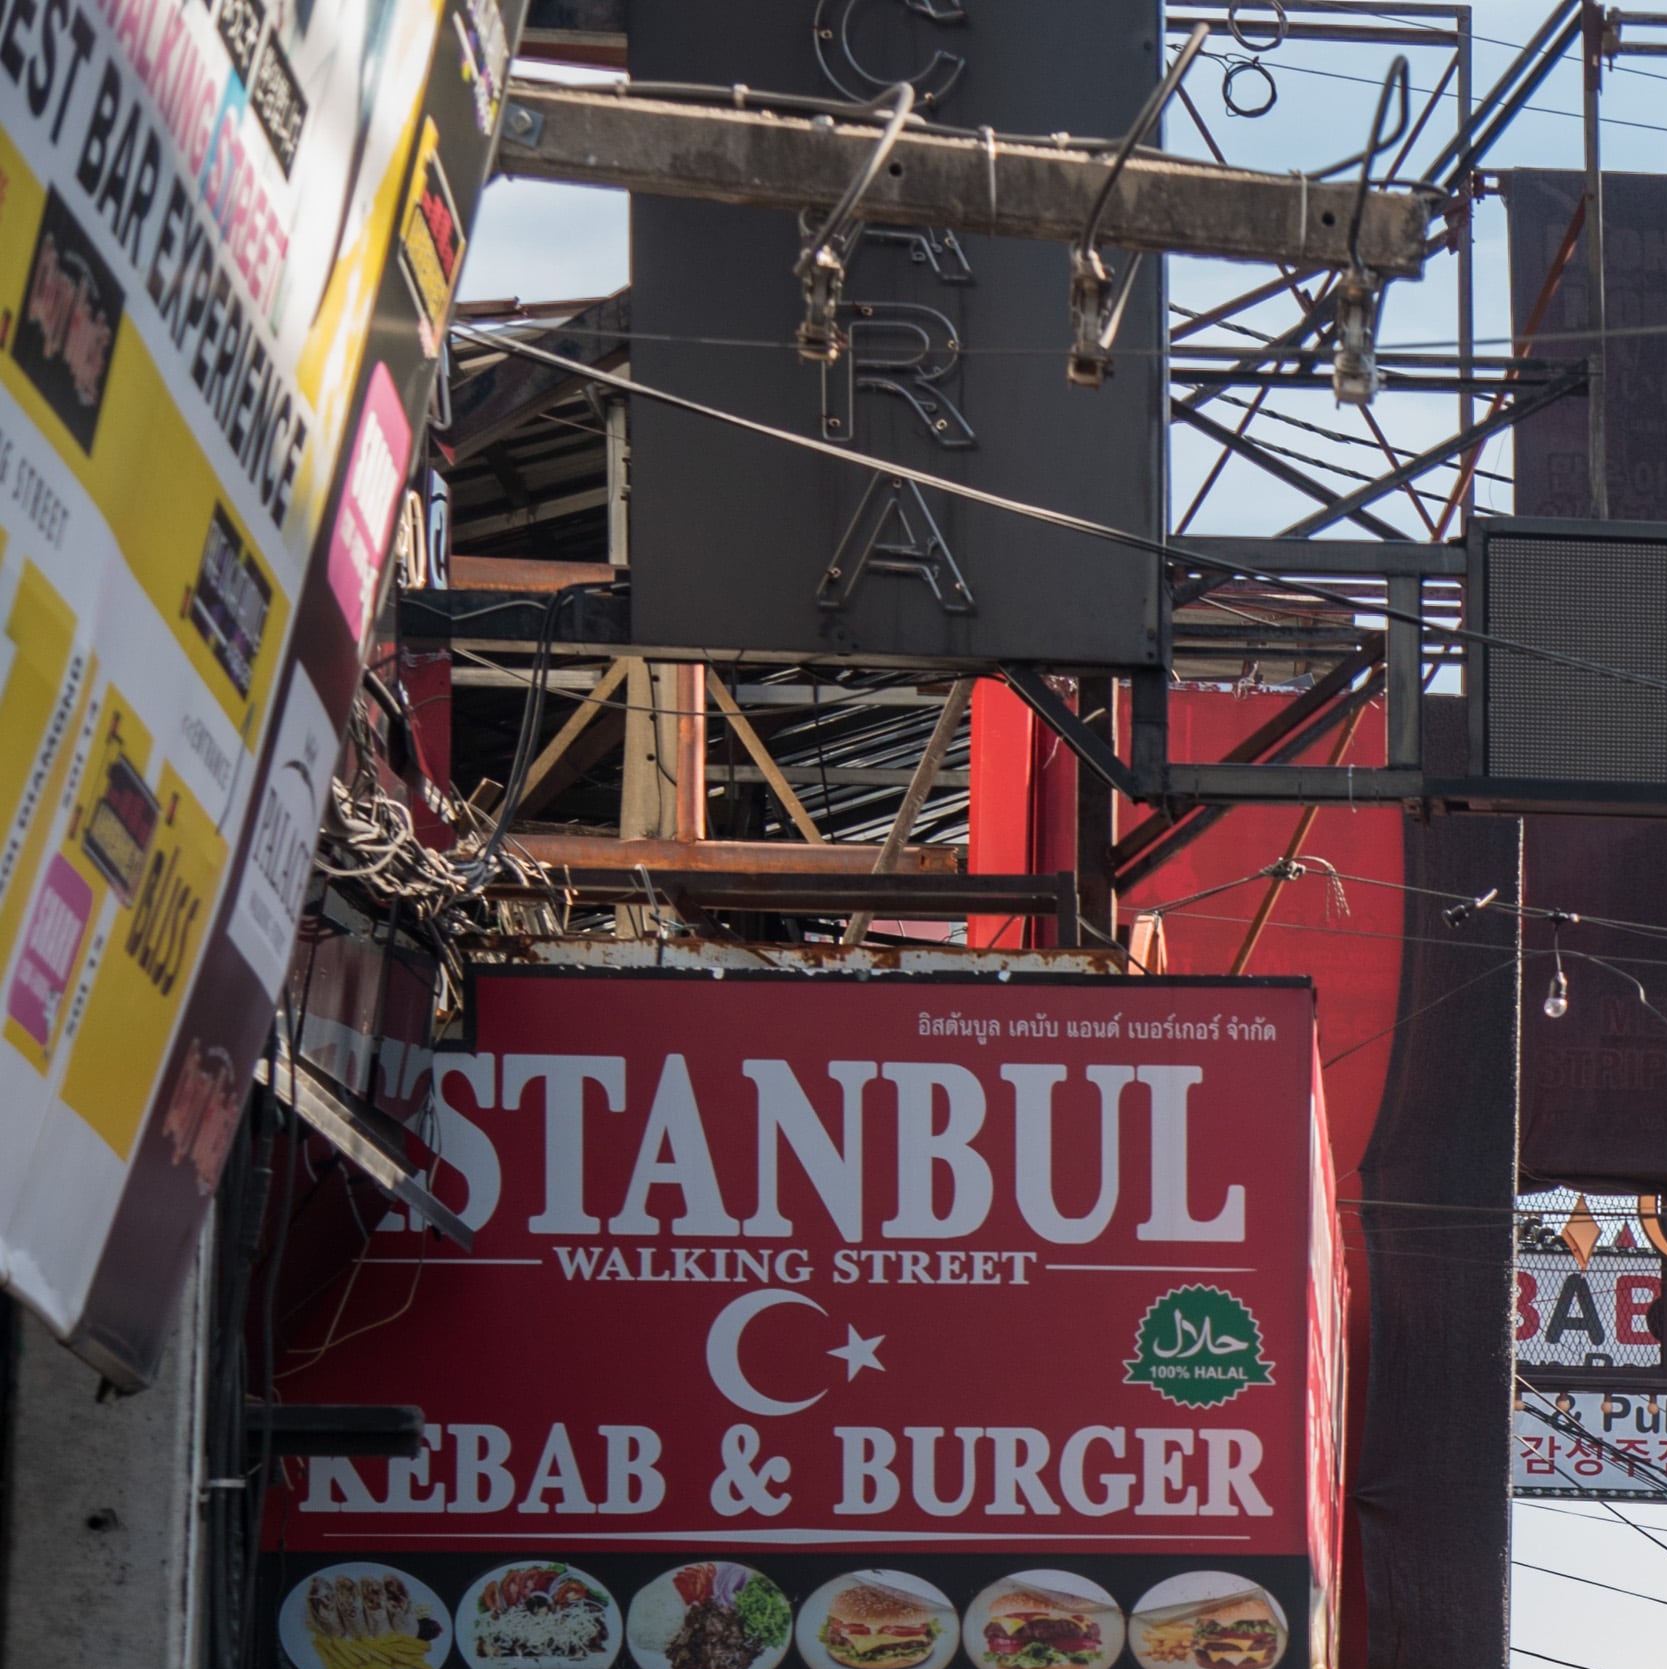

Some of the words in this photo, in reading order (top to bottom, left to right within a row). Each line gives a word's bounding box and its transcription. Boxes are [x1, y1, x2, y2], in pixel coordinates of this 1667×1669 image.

[76, 57, 162, 268] BAR
[146, 173, 307, 531] EXPERIENCE
[1008, 1014, 1059, 1039] เคบับ
[1067, 1013, 1120, 1039] แอนด์
[1128, 1014, 1220, 1041] เบอร์เกอร์
[1227, 1017, 1276, 1041] จำกัด
[373, 1053, 1246, 1244] STANBUL
[554, 1246, 814, 1284] WALKING
[832, 1249, 1038, 1285] STREET
[1151, 1309, 1250, 1360] حلال
[1149, 1366, 1191, 1381] 100%
[1193, 1366, 1249, 1381] HALAL
[300, 1423, 666, 1515] KEBAB
[710, 1424, 793, 1517] &
[834, 1426, 1274, 1517] BURGER
